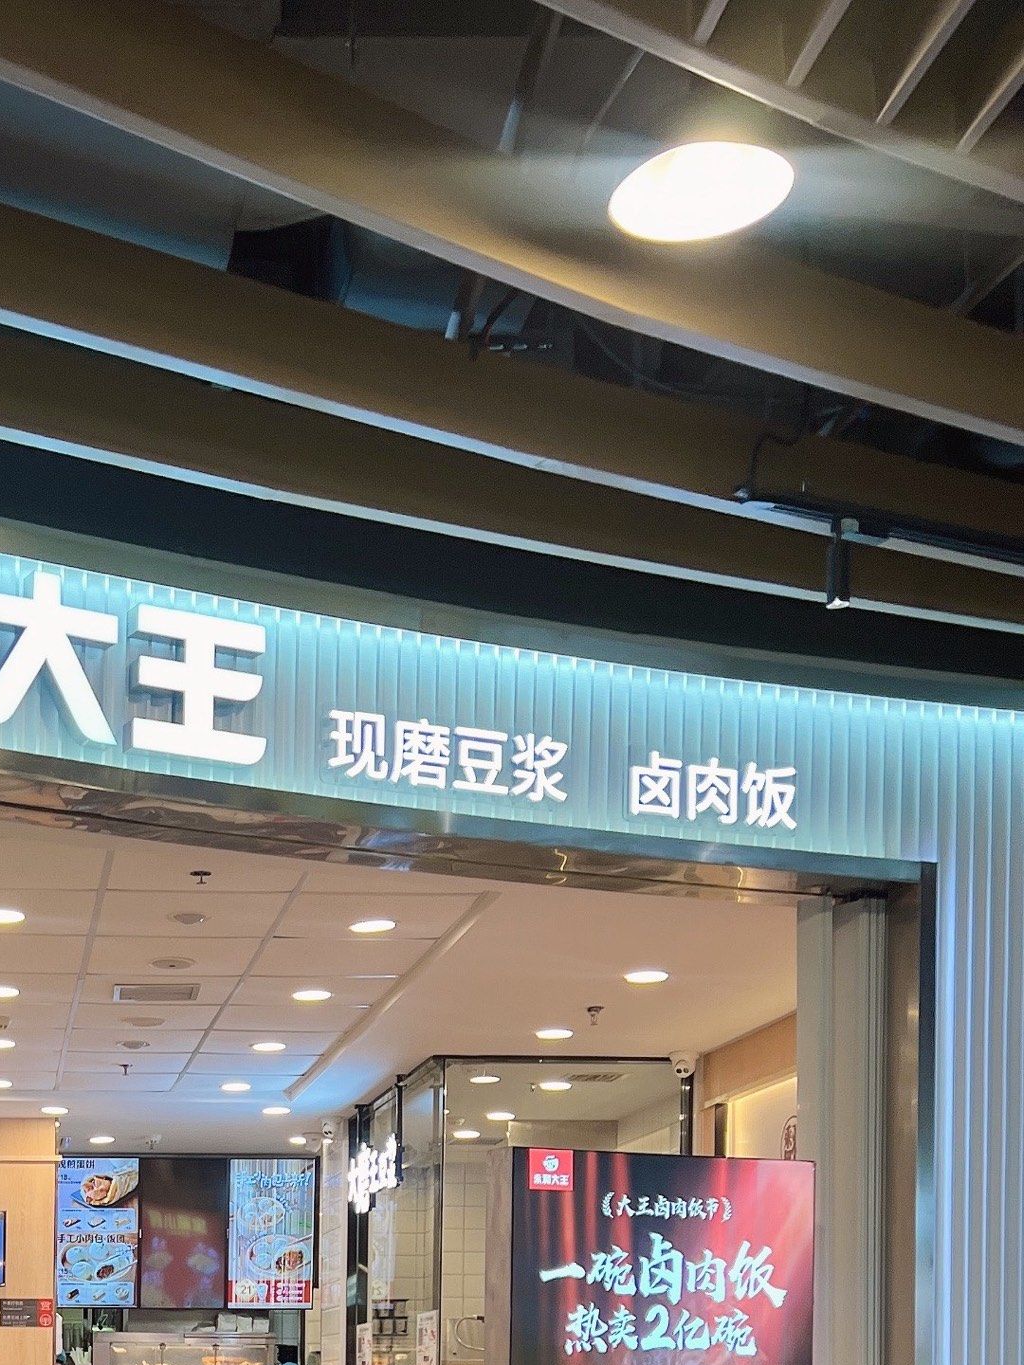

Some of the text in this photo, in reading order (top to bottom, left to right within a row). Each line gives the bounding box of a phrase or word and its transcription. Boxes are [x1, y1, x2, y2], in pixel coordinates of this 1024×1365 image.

[328, 709, 798, 831] 现磨豆浆 卤肉饭
[533, 1173, 570, 1187] 永和大王
[539, 1231, 788, 1308] 一碗卤肉饭
[564, 1302, 757, 1356] 热卖2亿碗
